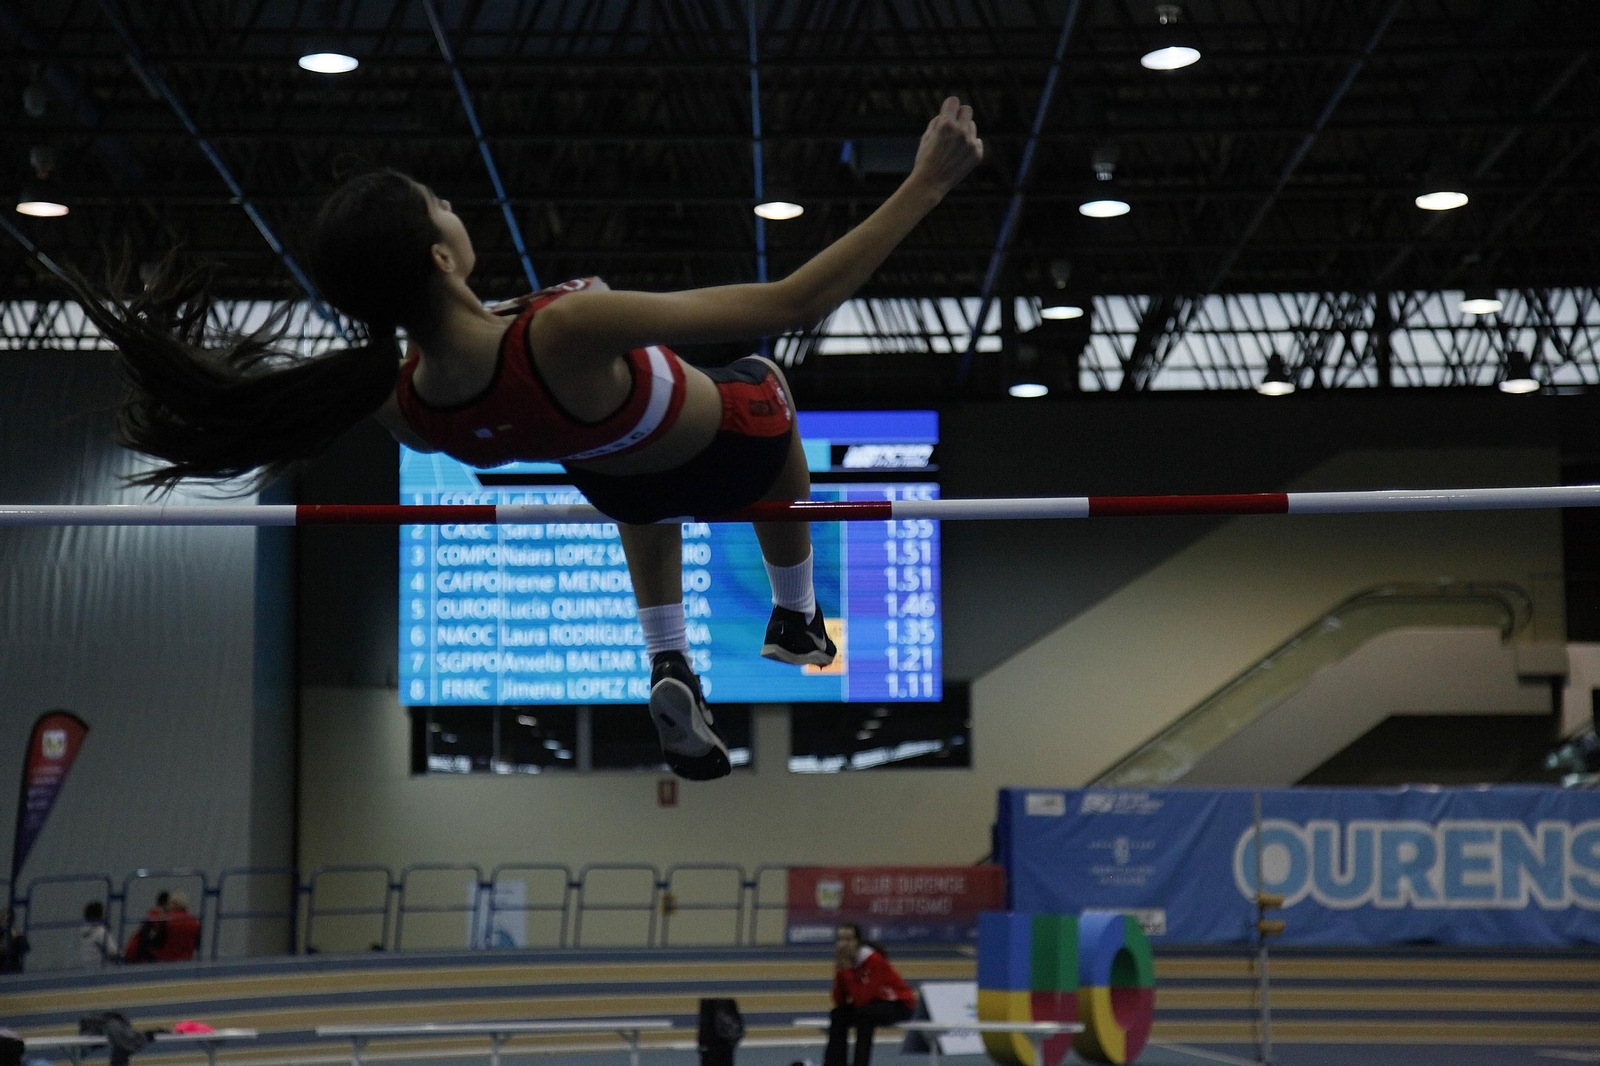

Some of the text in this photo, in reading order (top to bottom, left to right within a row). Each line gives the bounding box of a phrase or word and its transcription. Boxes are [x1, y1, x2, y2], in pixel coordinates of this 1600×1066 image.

[410, 524, 425, 540] 2
[882, 519, 934, 539] 1.55
[410, 544, 425, 567] 3
[882, 539, 932, 565] 1.51
[410, 571, 425, 593] 4
[883, 565, 932, 592] 1.51
[411, 597, 425, 620] 5
[884, 591, 936, 618] 1.46
[410, 624, 425, 647] 6
[502, 624, 548, 647] Laura
[884, 618, 935, 645] 1.35
[412, 651, 425, 673] 7
[885, 645, 932, 671] 1.21
[410, 679, 425, 700] 8
[885, 672, 933, 699] 1.11
